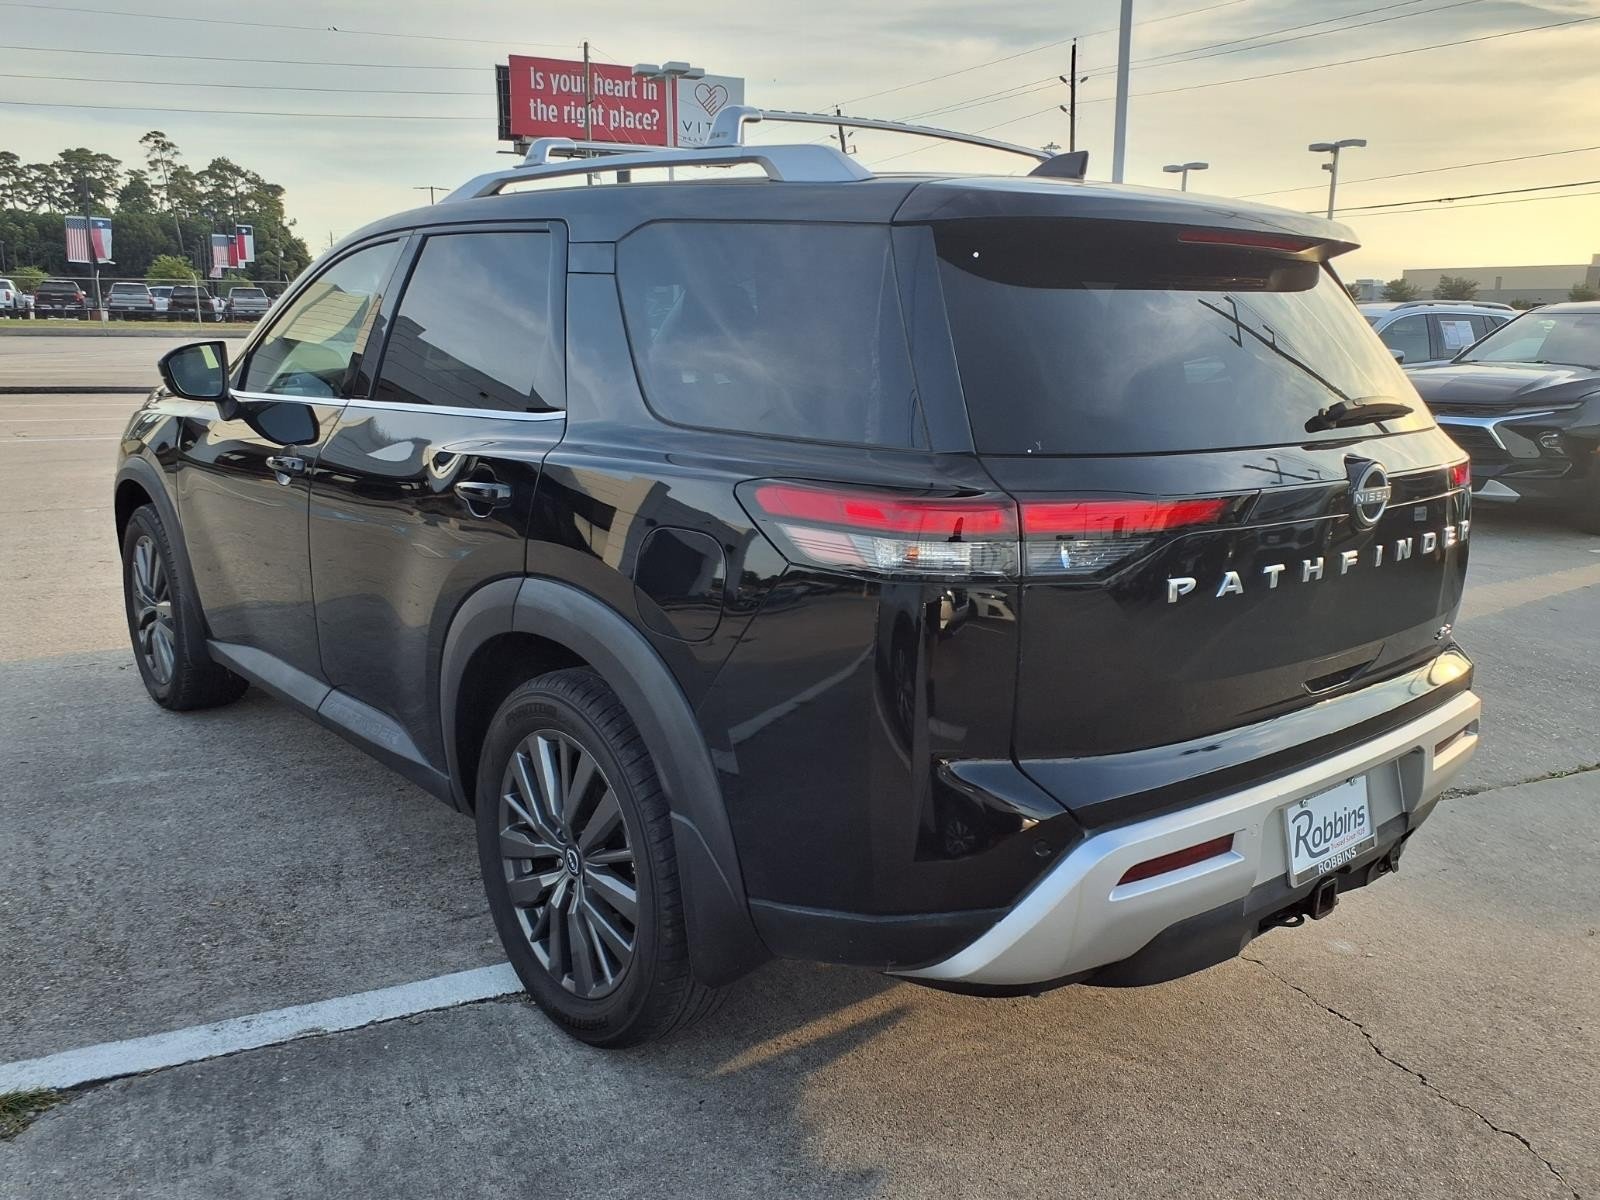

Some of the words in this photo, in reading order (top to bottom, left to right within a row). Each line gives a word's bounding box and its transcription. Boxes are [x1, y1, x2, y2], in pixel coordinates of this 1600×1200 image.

[529, 66, 544, 90] Is
[594, 72, 638, 100] heart
[642, 75, 658, 101] in
[529, 98, 558, 122] the
[563, 100, 605, 129] right
[610, 106, 660, 131] place?
[1167, 519, 1471, 604] PATHFINDER
[1291, 805, 1365, 858] Robbins
[1318, 847, 1357, 874] ROBBINS
